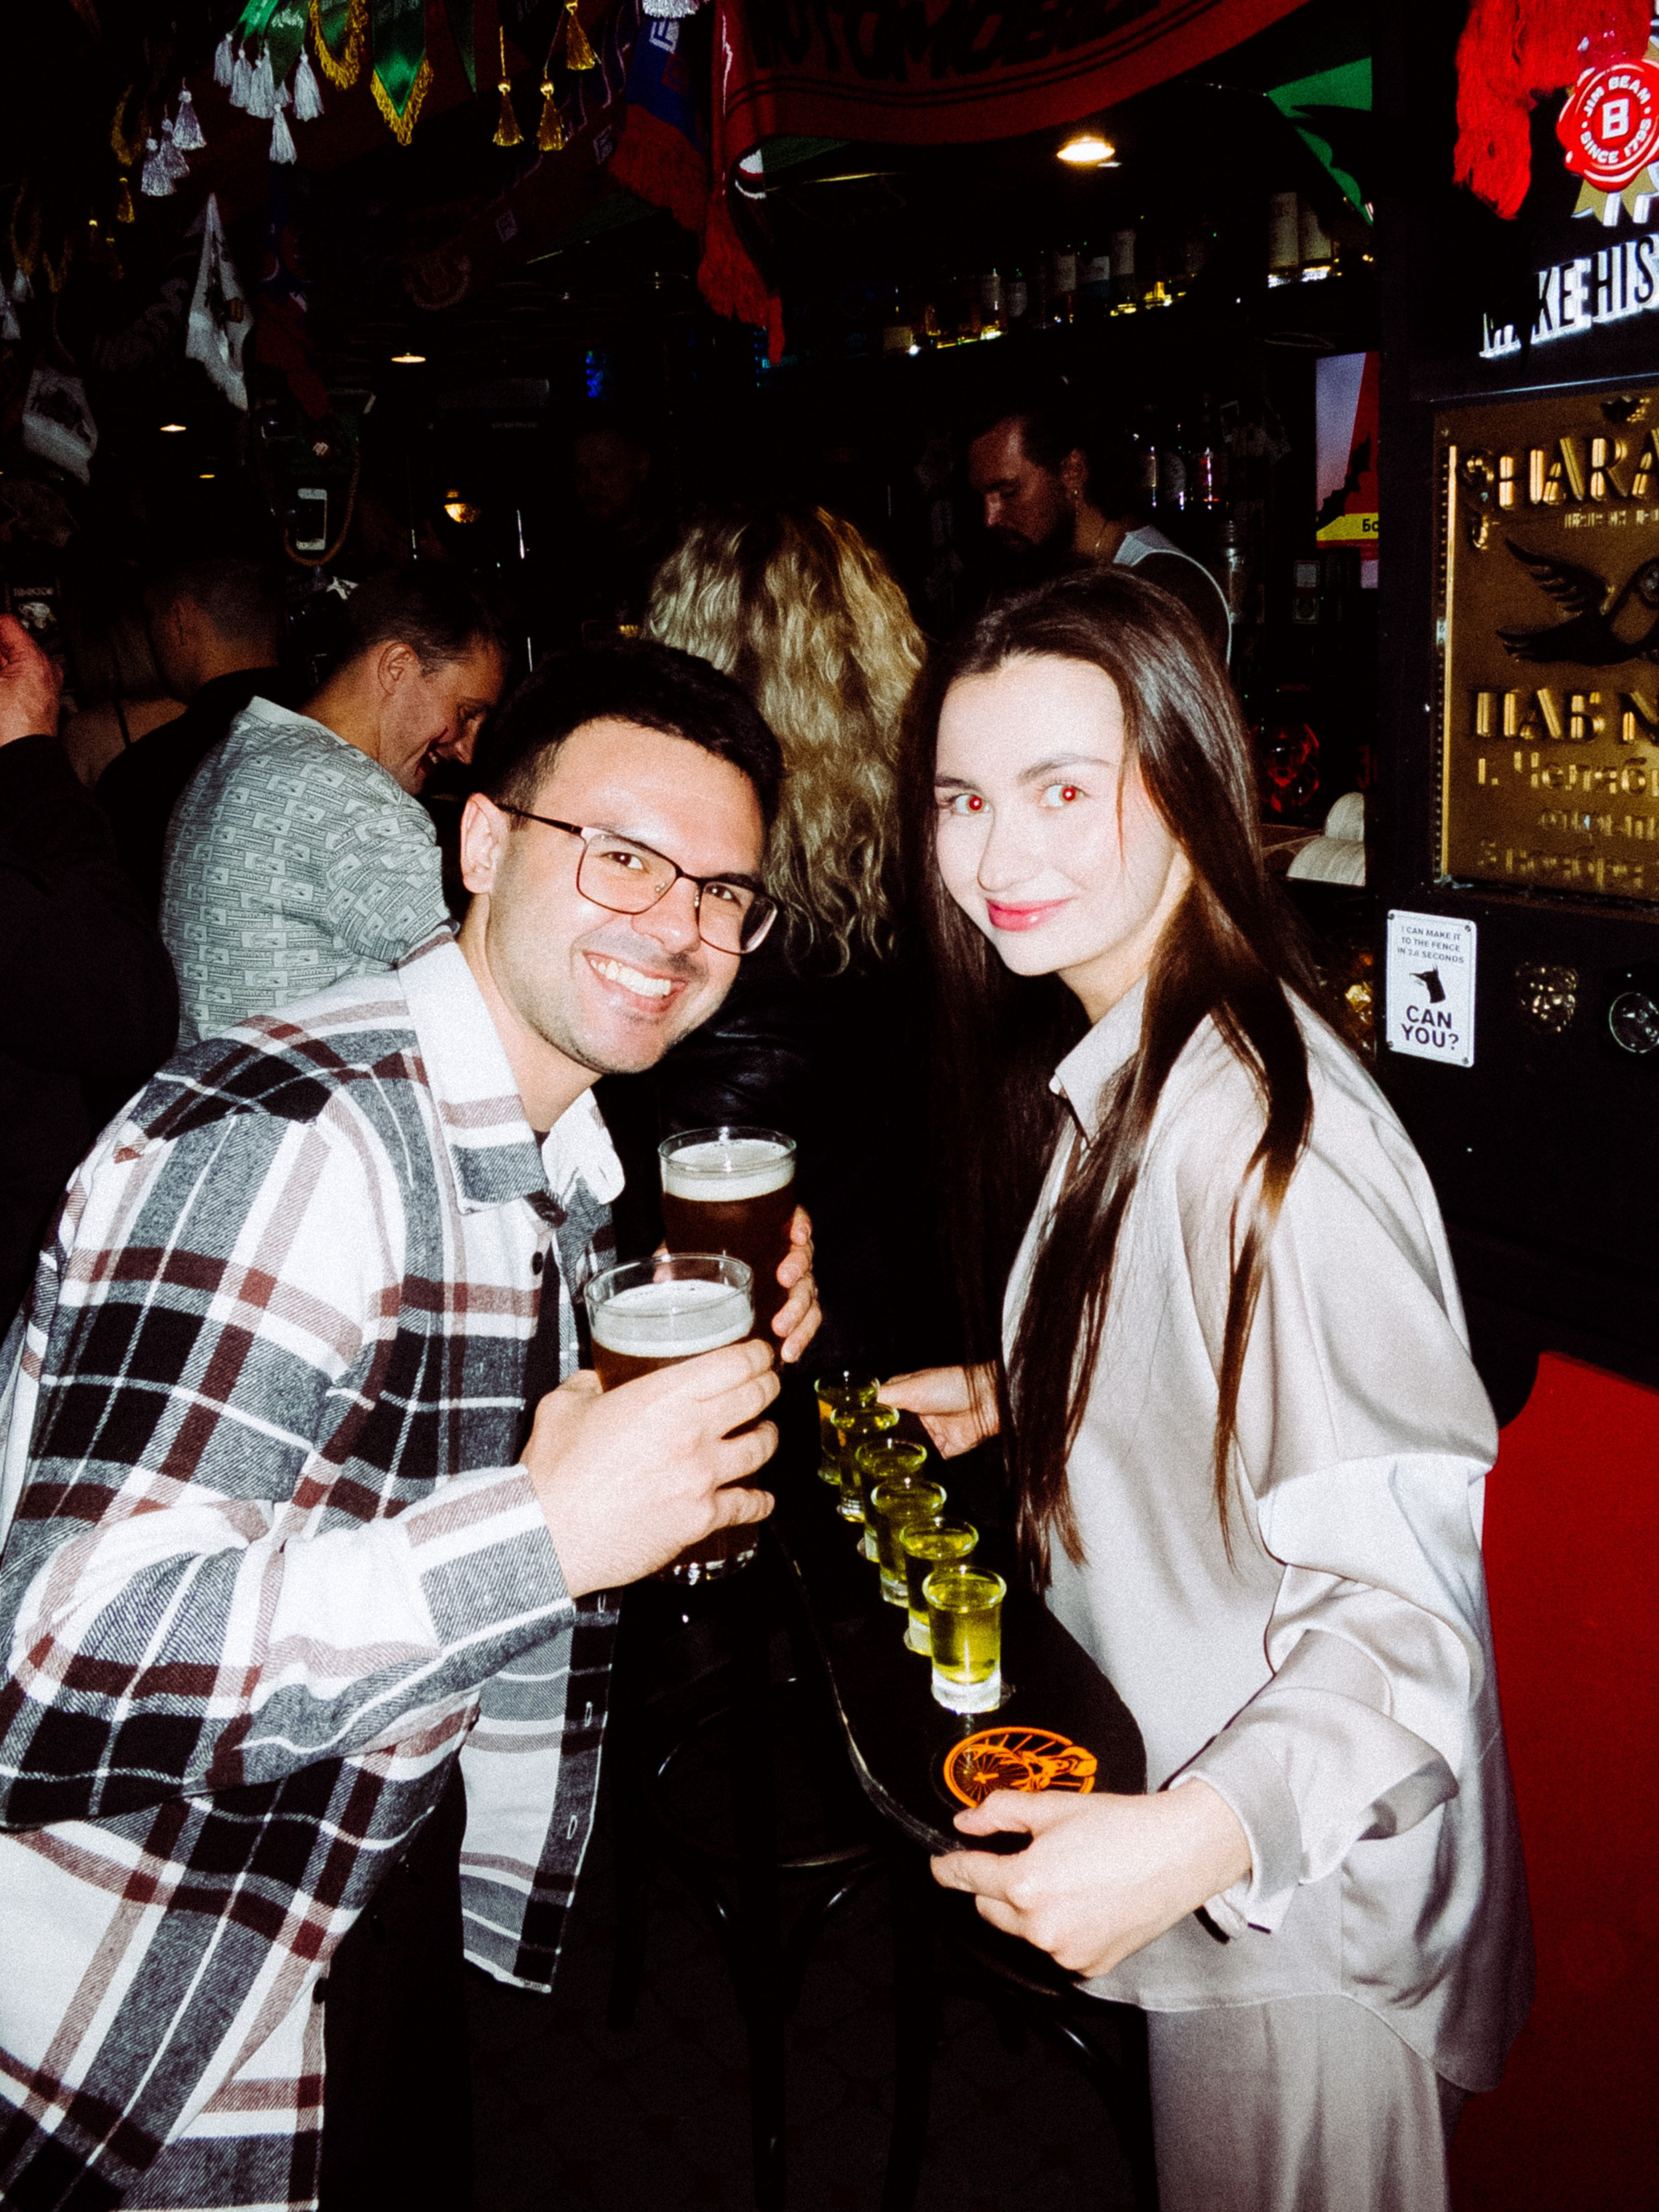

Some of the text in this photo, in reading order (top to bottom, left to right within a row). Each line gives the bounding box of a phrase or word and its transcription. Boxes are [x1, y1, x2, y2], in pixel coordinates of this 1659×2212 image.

[1582, 74, 1652, 118] JIM BEAM
[1601, 97, 1630, 140] B
[1579, 117, 1653, 165] SINCE 1795
[1406, 926, 1423, 935] CAN
[1426, 930, 1451, 940] MAKE
[1414, 938, 1429, 947] THE
[1431, 941, 1460, 952] FENCE
[1422, 950, 1465, 964] SECONDS
[1406, 1005, 1452, 1029] CAN
[1401, 1023, 1459, 1050] YOU?
